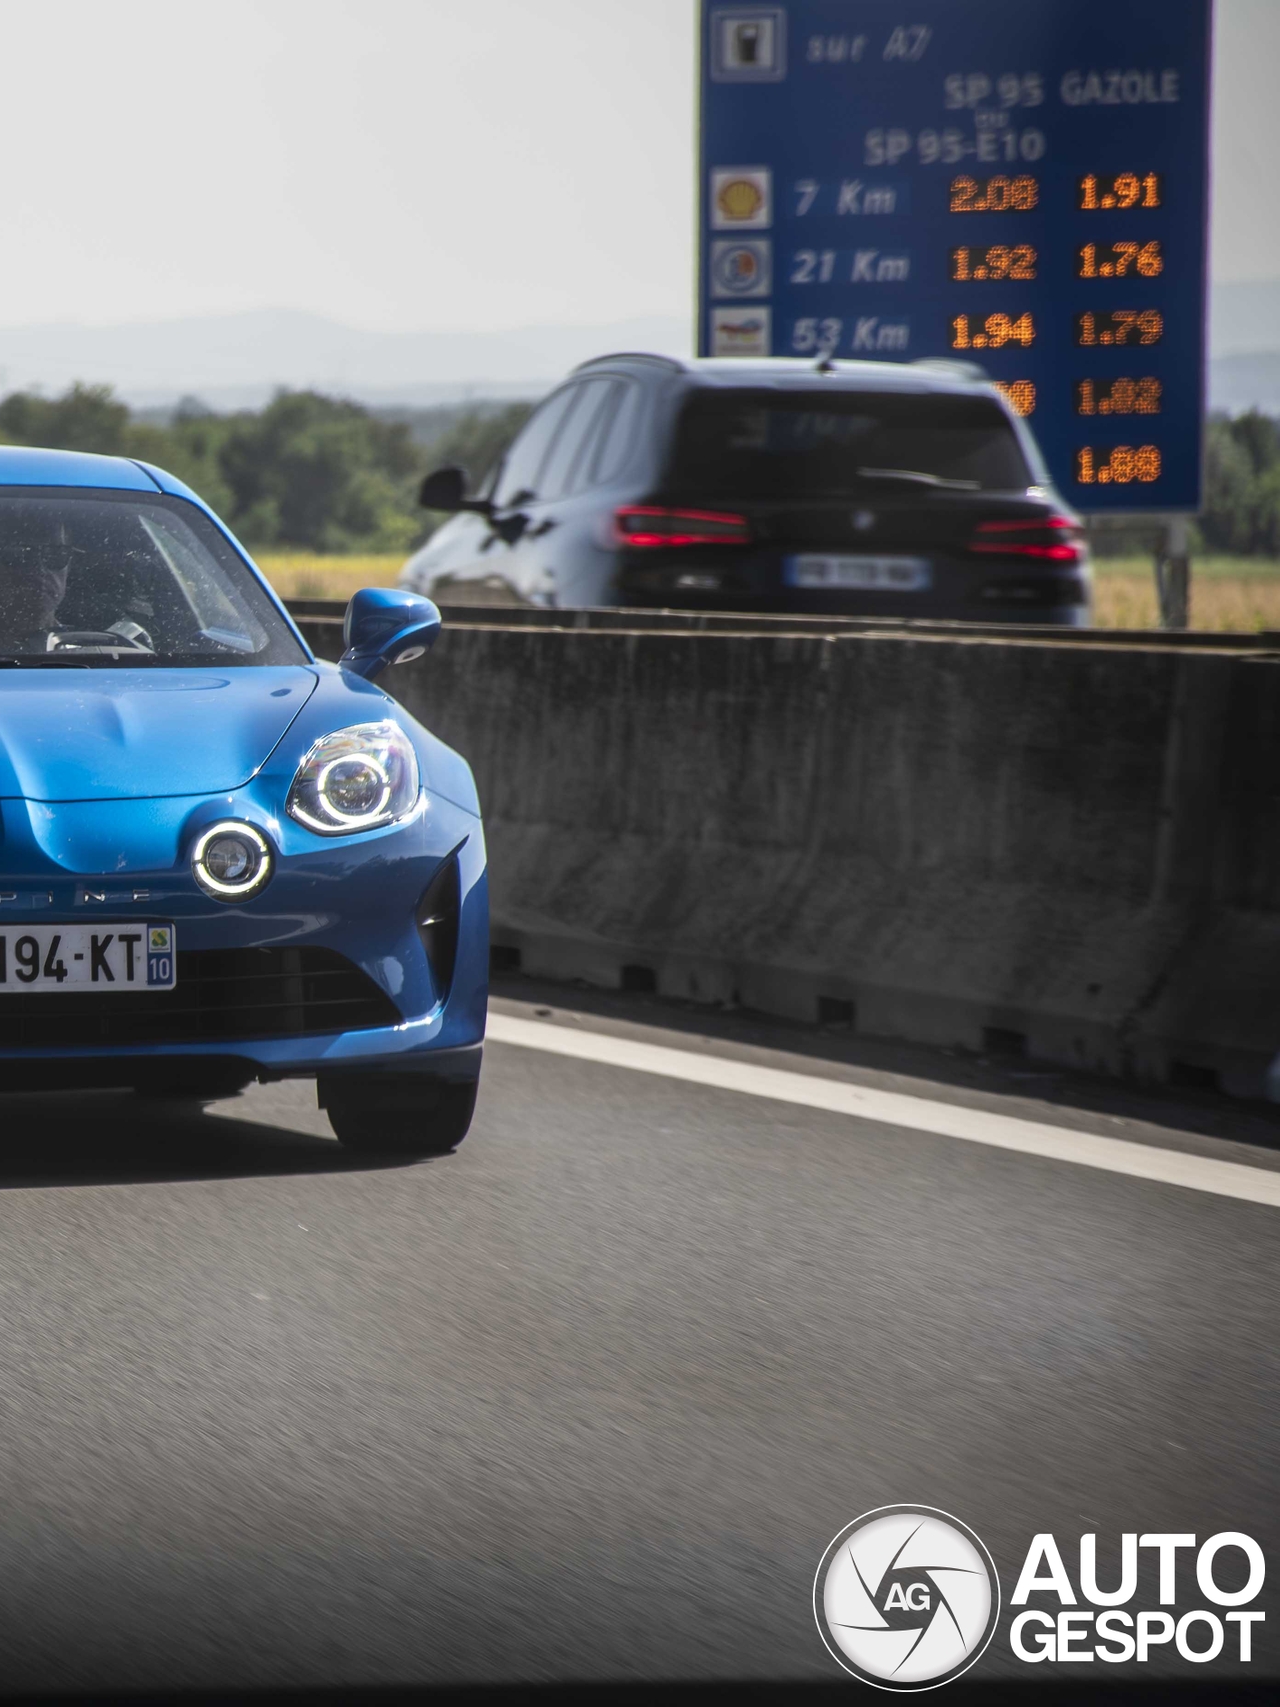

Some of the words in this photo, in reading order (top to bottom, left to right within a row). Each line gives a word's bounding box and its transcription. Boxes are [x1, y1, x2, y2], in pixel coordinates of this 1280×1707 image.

[806, 35, 867, 62] sur
[883, 25, 933, 61] A7
[944, 73, 991, 109] SP
[997, 73, 1044, 107] 95
[1060, 69, 1180, 105] GAZOLE
[864, 128, 911, 165] SP
[917, 127, 1047, 164] 95-E10
[794, 180, 819, 216] 7
[837, 179, 896, 215] Km
[950, 175, 1039, 212] 2.08
[1080, 172, 1161, 209] 1.91
[790, 250, 836, 283] 21
[850, 248, 910, 282] Km
[952, 246, 1038, 280] 1.92
[1079, 241, 1164, 278] 1.76
[792, 317, 843, 351] 53
[852, 317, 910, 351] Km
[952, 312, 1036, 348] 1.94
[1079, 310, 1164, 346] 1.79
[149, 957, 170, 980] 10
